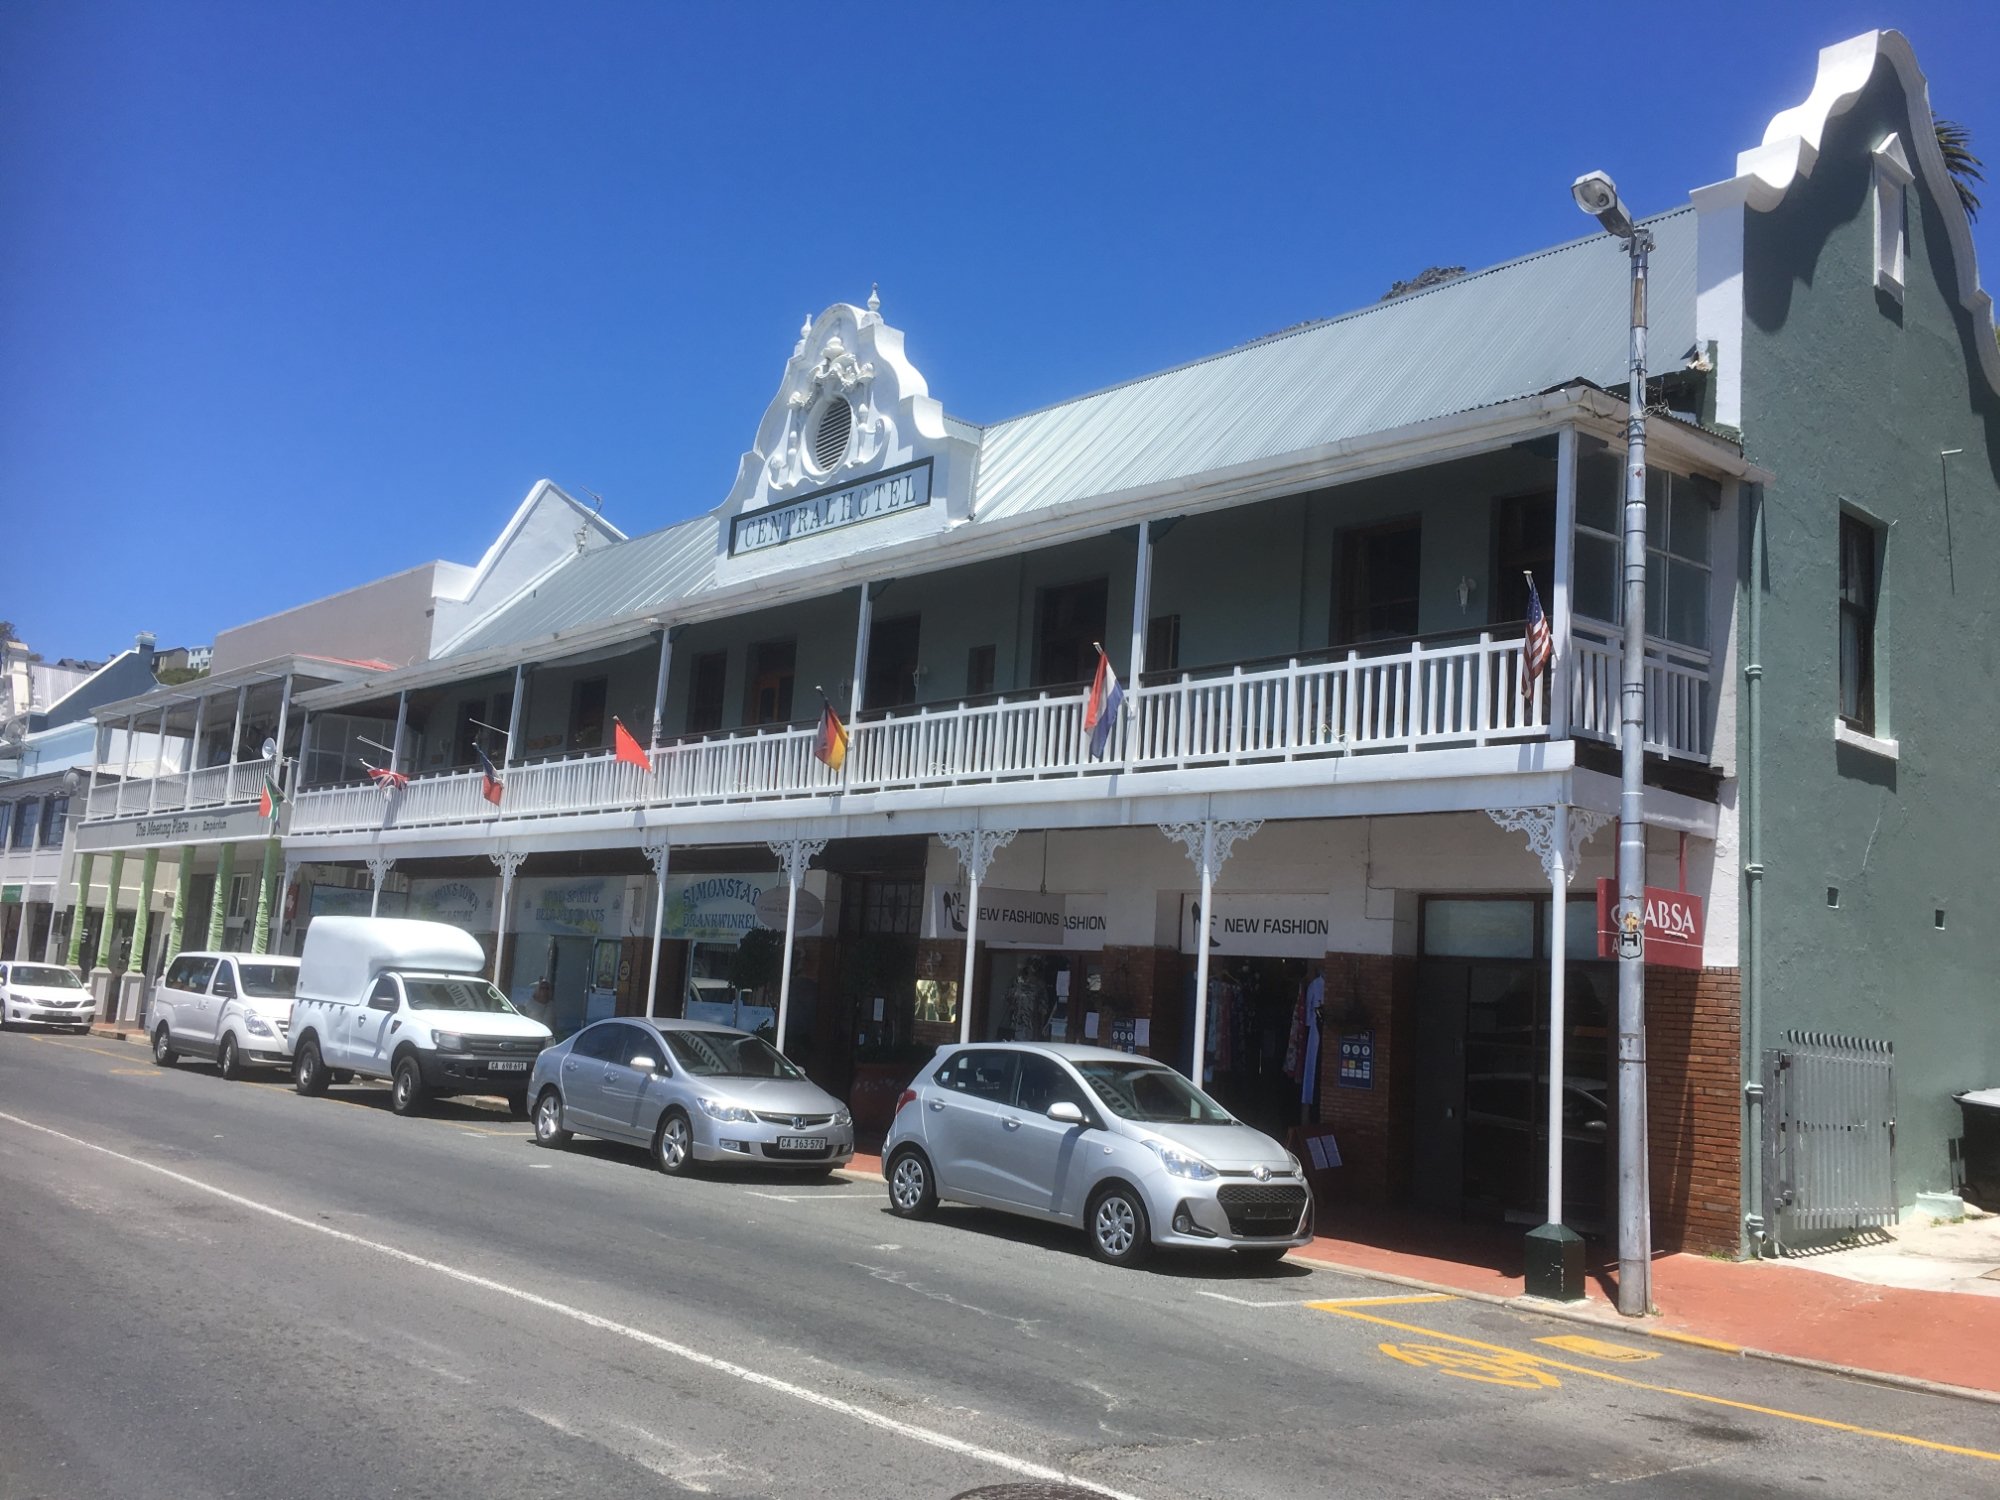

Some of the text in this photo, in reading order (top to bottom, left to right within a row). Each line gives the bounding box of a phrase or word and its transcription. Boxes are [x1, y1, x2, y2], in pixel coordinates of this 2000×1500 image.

[745, 474, 917, 547] CENTRAL HOTEL
[136, 823, 146, 837] The
[147, 821, 171, 838] Meeting
[172, 819, 189, 834] Place
[683, 912, 758, 929] DRANKWINKEL
[977, 907, 1059, 926] EW FASHIONS
[1063, 916, 1107, 931] ASHION
[1643, 899, 1696, 934] ABSA
[1224, 918, 1260, 933] NEW
[1264, 919, 1329, 935] FASHION
[781, 1138, 791, 1148] CA
